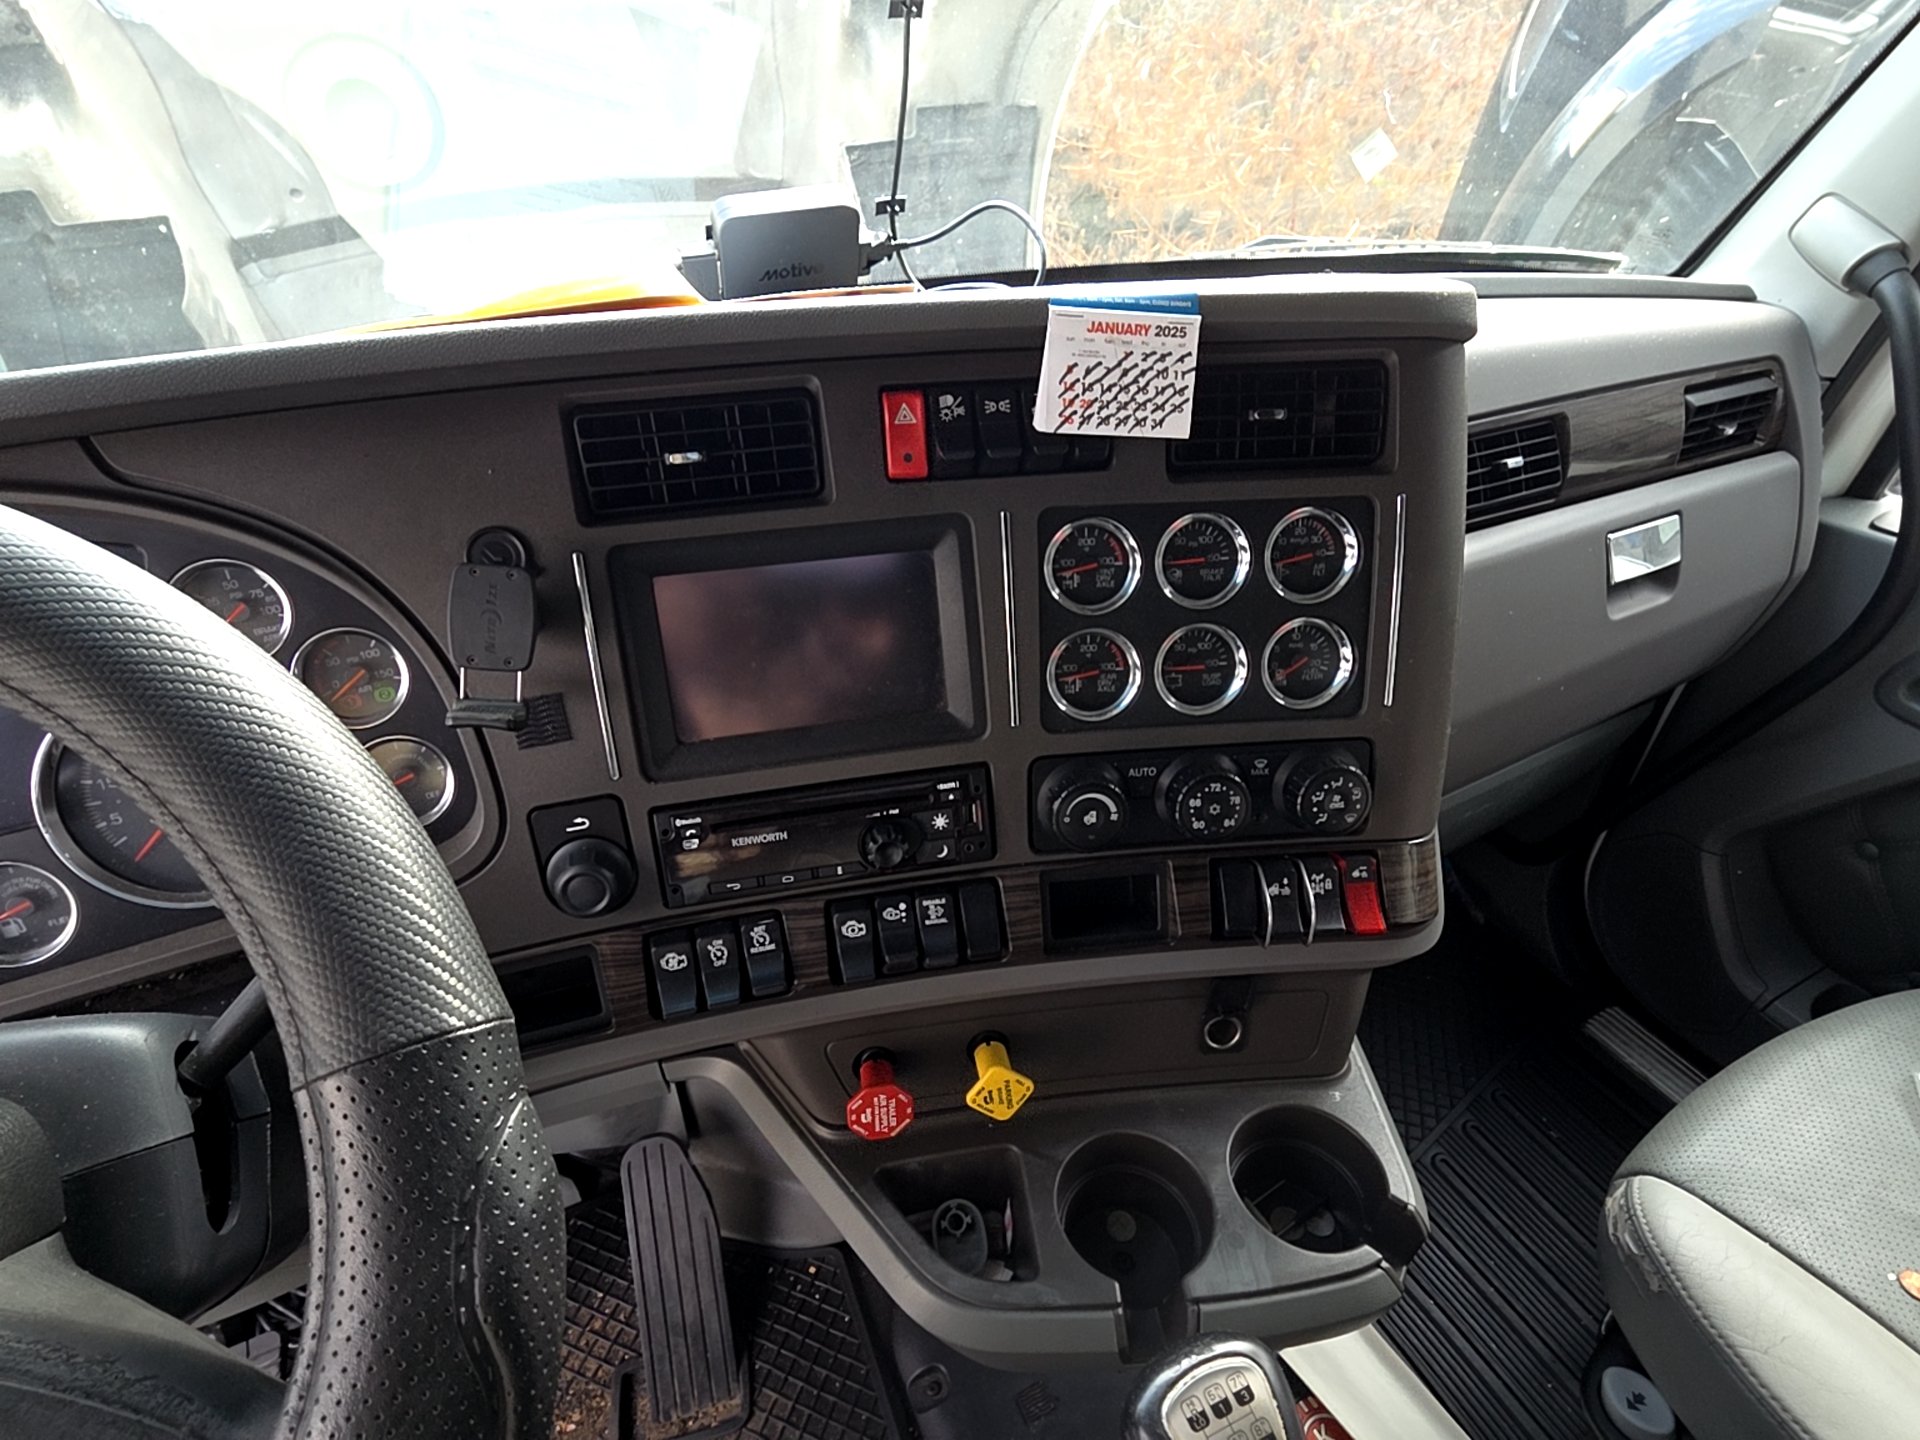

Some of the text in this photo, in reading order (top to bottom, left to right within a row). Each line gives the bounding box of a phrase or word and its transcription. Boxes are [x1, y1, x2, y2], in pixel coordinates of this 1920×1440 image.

[1087, 321, 1188, 338] JANUARY 2025
[1078, 538, 1096, 546] 200
[1175, 537, 1186, 545] 50
[1198, 536, 1214, 544] 100
[1310, 536, 1322, 544] 30
[222, 580, 240, 590] 50
[248, 589, 264, 598] 75
[1080, 644, 1098, 652] 200
[326, 657, 340, 667] 50
[360, 648, 380, 660] 100
[332, 668, 394, 688] 0 150
[358, 685, 373, 694] AIR
[1128, 767, 1157, 778] AUTO
[1210, 783, 1222, 792] 72
[109, 812, 122, 826] 5
[1192, 820, 1206, 830] 60
[731, 830, 788, 848] KENWORTH
[1004, 1080, 1014, 1110] PARKING
[878, 1094, 888, 1132] AIR SUPPLY
[888, 1098, 897, 1127] TRAILER
[1230, 1378, 1237, 1388] 7
[1206, 1390, 1216, 1401] 5
[1240, 1390, 1250, 1402] 3
[1218, 1403, 1227, 1414] 1
